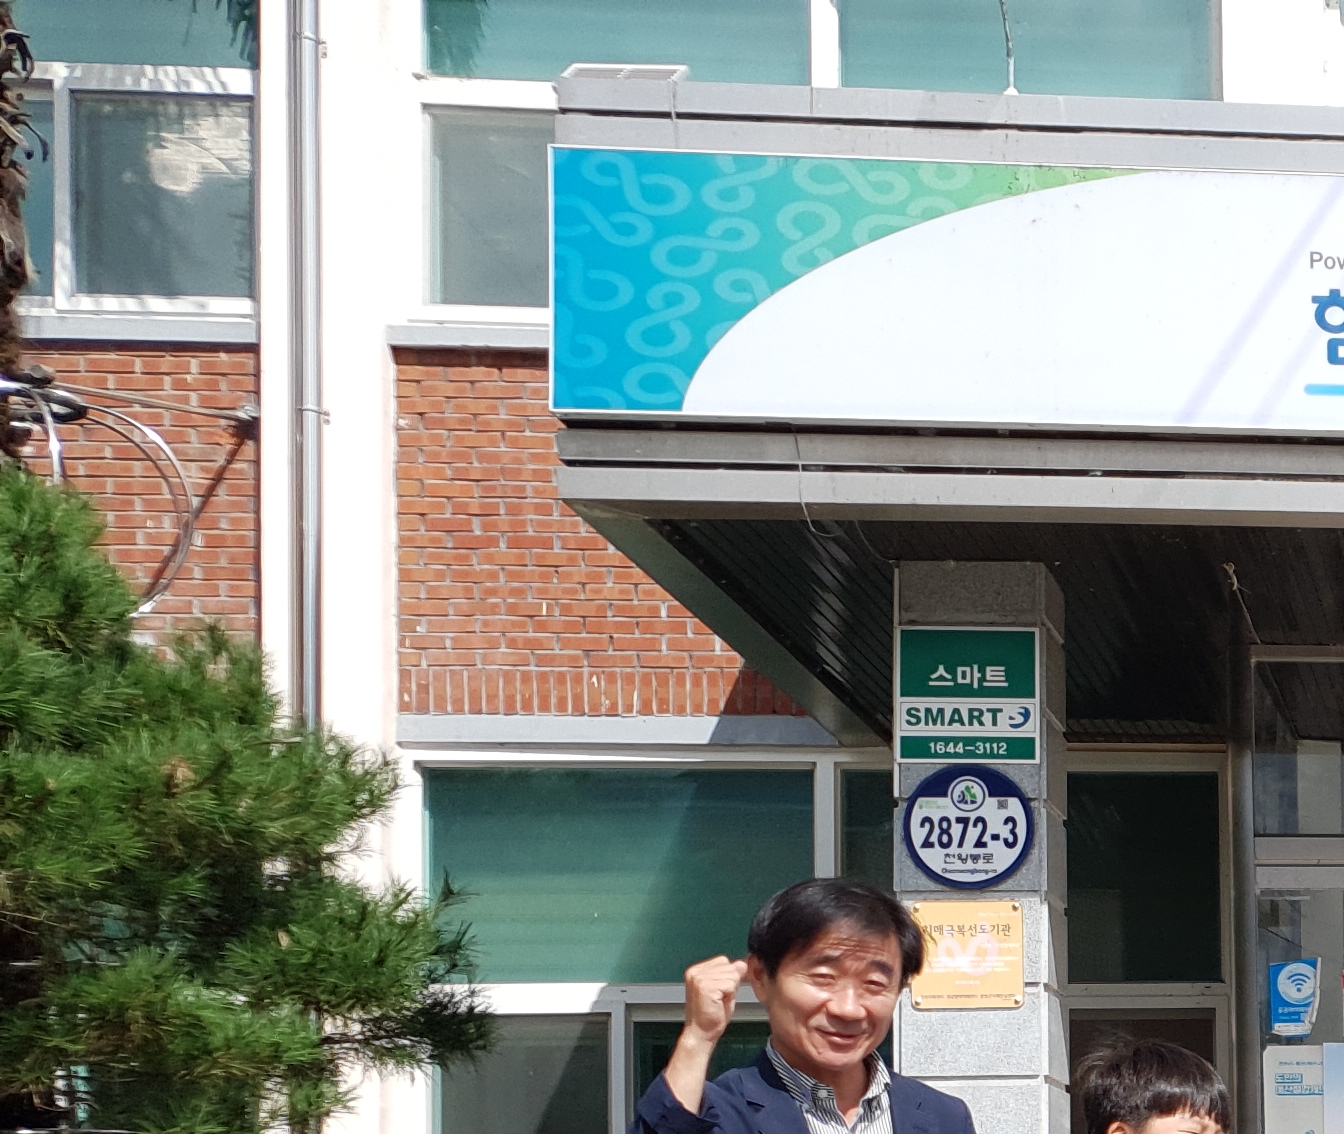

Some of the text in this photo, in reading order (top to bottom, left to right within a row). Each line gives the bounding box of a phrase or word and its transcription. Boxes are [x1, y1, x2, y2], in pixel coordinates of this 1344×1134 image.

[928, 664, 1009, 689] 스마트
[905, 707, 1004, 728] SMART
[929, 741, 1008, 756] 1644-3112
[919, 815, 1019, 849] 2872-3
